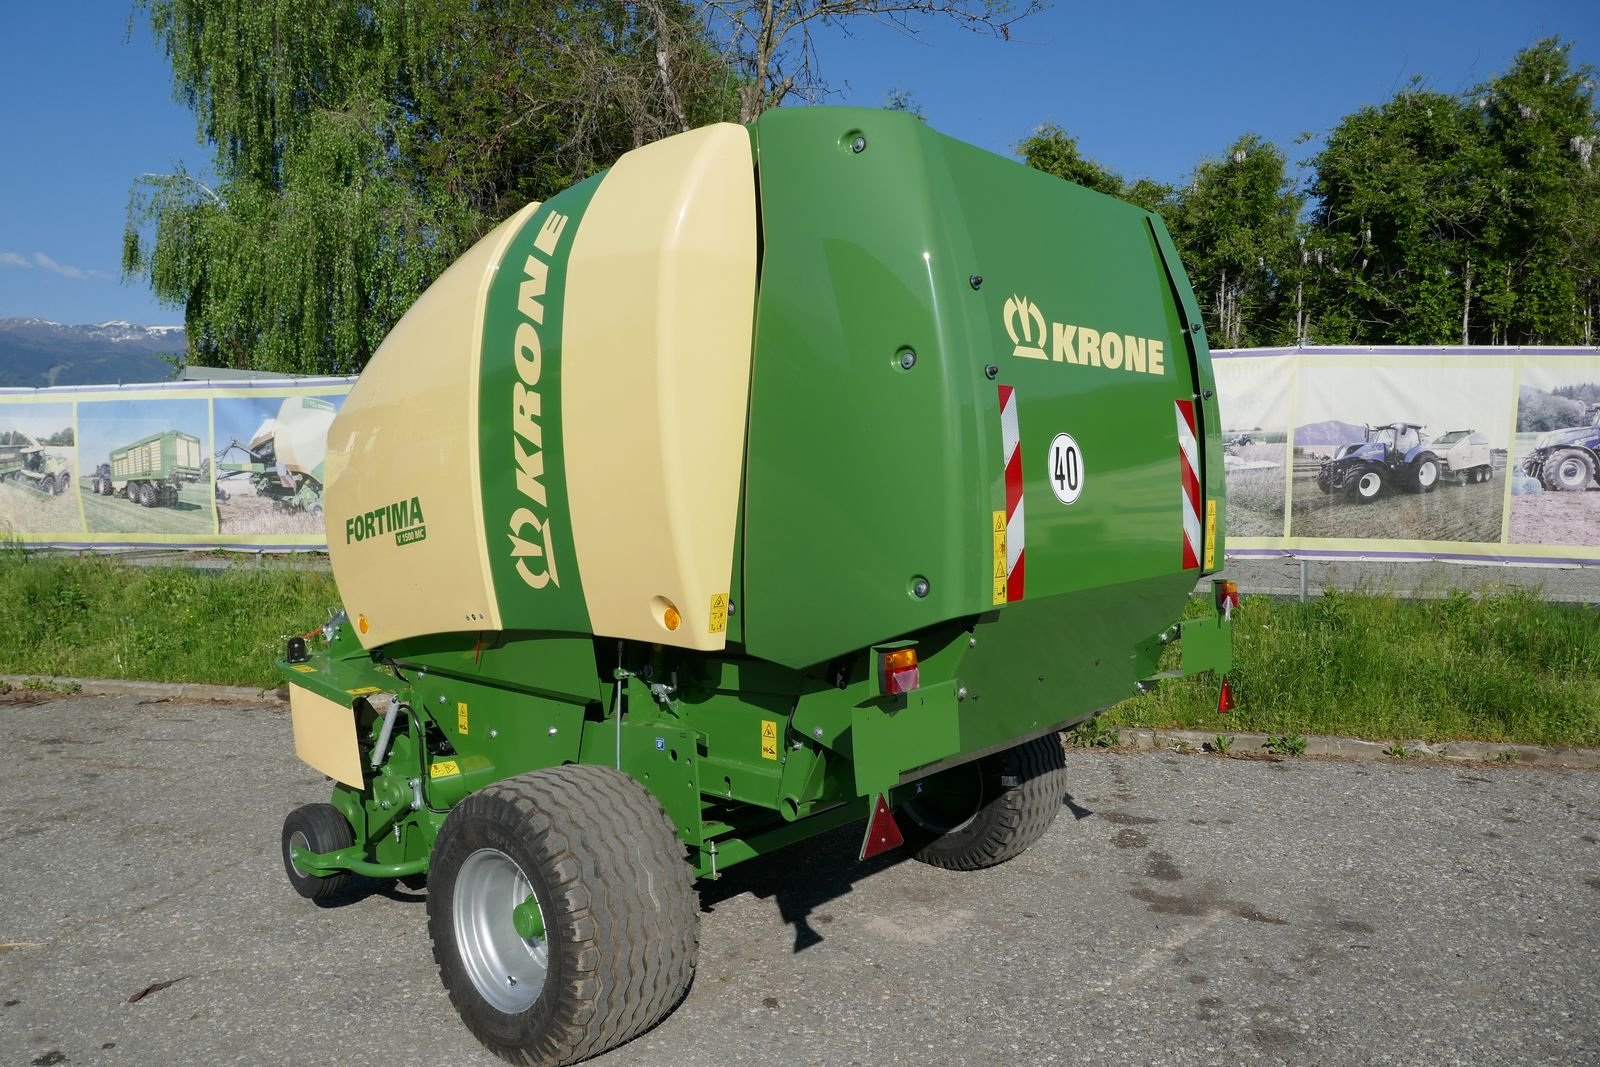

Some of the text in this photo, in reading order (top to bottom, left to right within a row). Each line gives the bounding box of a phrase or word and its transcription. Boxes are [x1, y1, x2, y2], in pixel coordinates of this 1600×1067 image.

[513, 210, 569, 508] KRONE
[1052, 322, 1165, 375] KRONE
[1055, 446, 1078, 491] 40
[346, 496, 424, 545] FORTIMA
[396, 529, 424, 543] V 1500 MC
